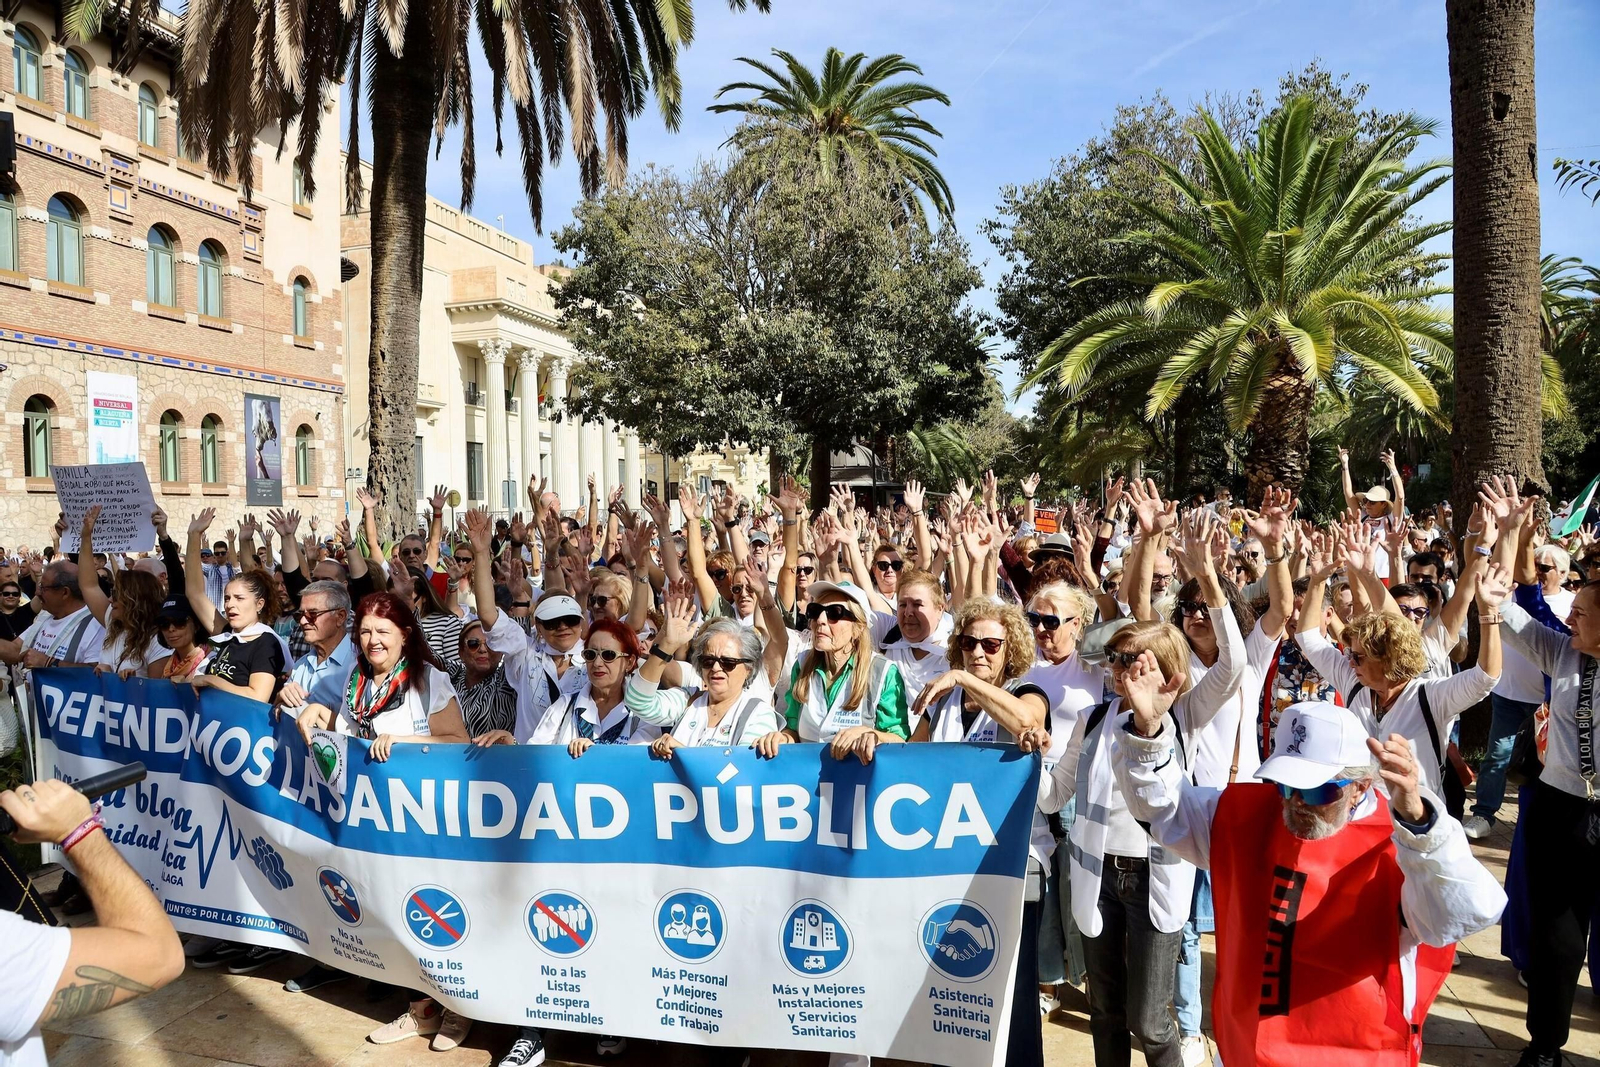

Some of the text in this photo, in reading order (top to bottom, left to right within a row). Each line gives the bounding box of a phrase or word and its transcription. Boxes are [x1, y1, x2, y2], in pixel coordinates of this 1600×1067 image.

[84, 479, 102, 488] ROBO
[1582, 669, 1595, 690] LOLA
[832, 716, 860, 724] blanca
[1580, 732, 1591, 758] LOLA
[40, 684, 279, 787] DEFENDMOS
[279, 745, 323, 814] LA
[652, 762, 998, 850] PÚBLICA
[166, 902, 308, 942] JUNT@S POR LA SANIDAD PÚBLICA
[338, 927, 349, 940] No
[356, 935, 363, 946] la
[330, 935, 380, 960] Privatización
[333, 947, 386, 970] de la Sanidad
[418, 957, 463, 970] No a los
[541, 965, 586, 978] No a las
[651, 967, 728, 987] Más Personal
[429, 979, 437, 990] la
[438, 985, 479, 1000] Sanidad
[547, 980, 581, 993] Listas
[662, 984, 717, 1001] y Mejores
[772, 983, 866, 997] Más y Mejores
[536, 994, 590, 1010] de espera
[778, 998, 863, 1009] Instalaciones
[928, 986, 994, 1008] Asistencia
[526, 1008, 604, 1026] Interminables
[656, 998, 723, 1019] Condiciones
[787, 1011, 857, 1024] y Servicios
[933, 1003, 990, 1024] Sanitaria
[660, 1014, 719, 1034] de Trabajo
[792, 1025, 856, 1039] Sanitarios
[932, 1020, 991, 1042] Universal
